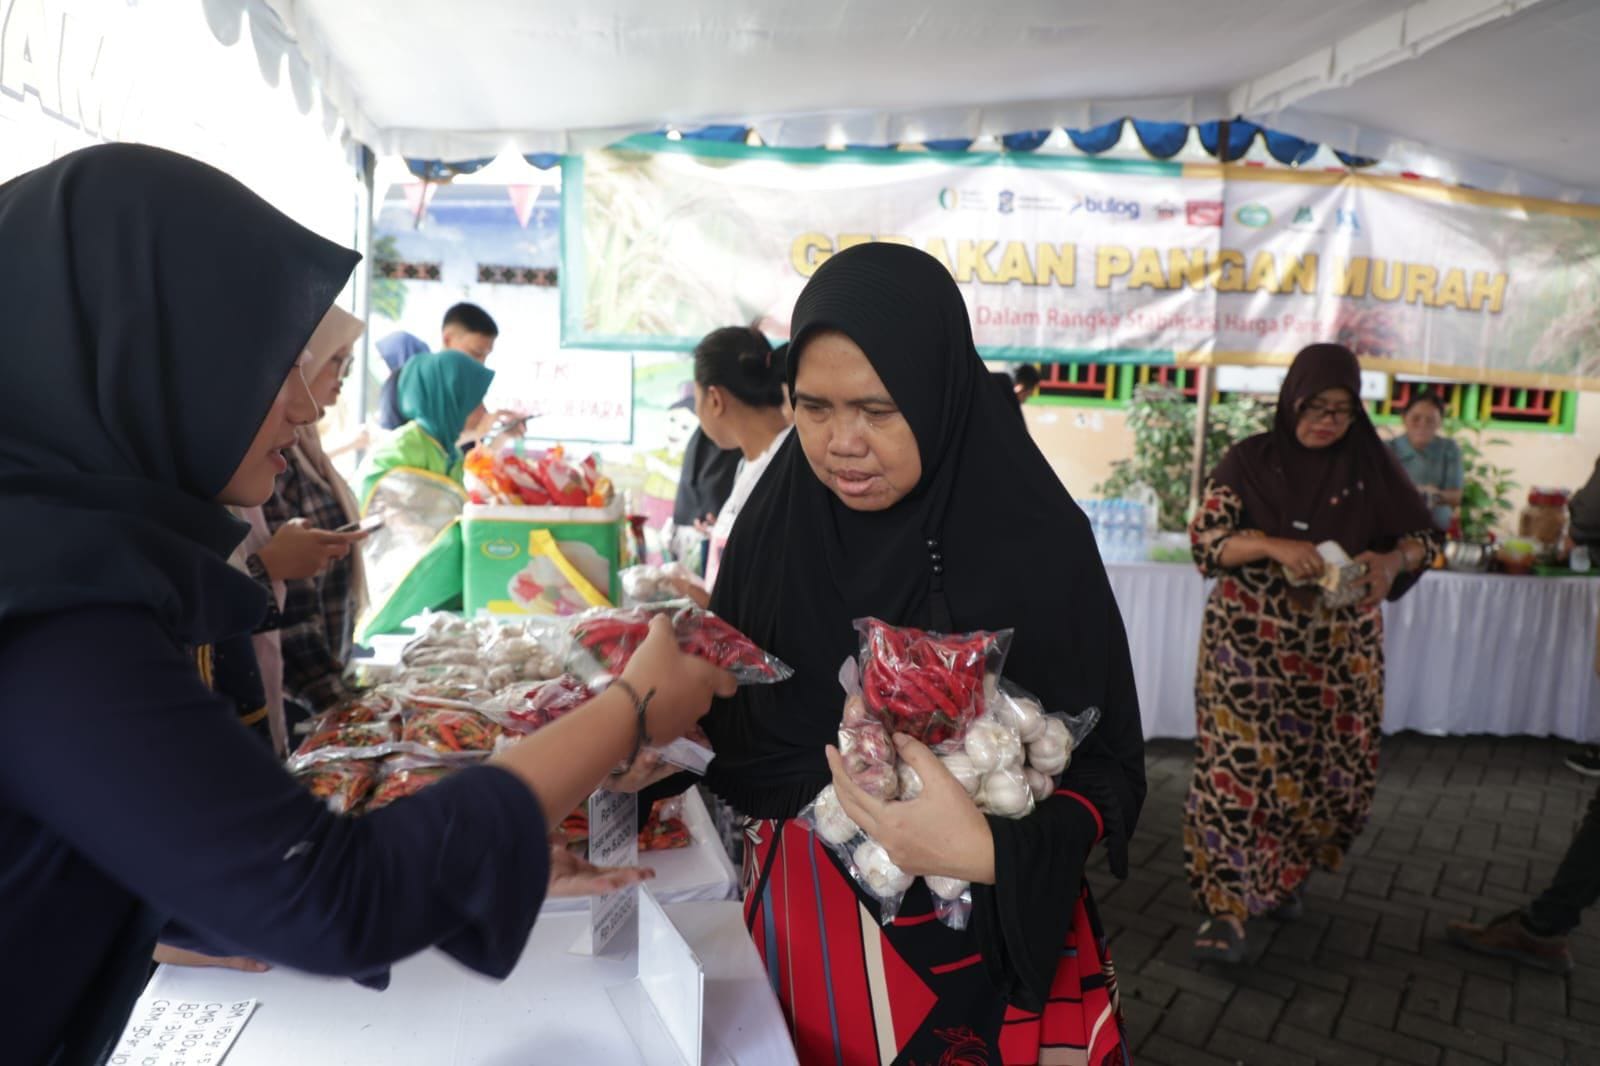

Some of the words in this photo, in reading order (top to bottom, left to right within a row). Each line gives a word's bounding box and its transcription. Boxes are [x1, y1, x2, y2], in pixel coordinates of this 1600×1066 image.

[1086, 196, 1140, 220] bulog
[1094, 246, 1320, 294] PANGAN
[1333, 256, 1508, 313] MURAH
[976, 306, 1041, 327] Dalam
[1047, 307, 1121, 332] Rangka
[1224, 314, 1281, 337] Harga
